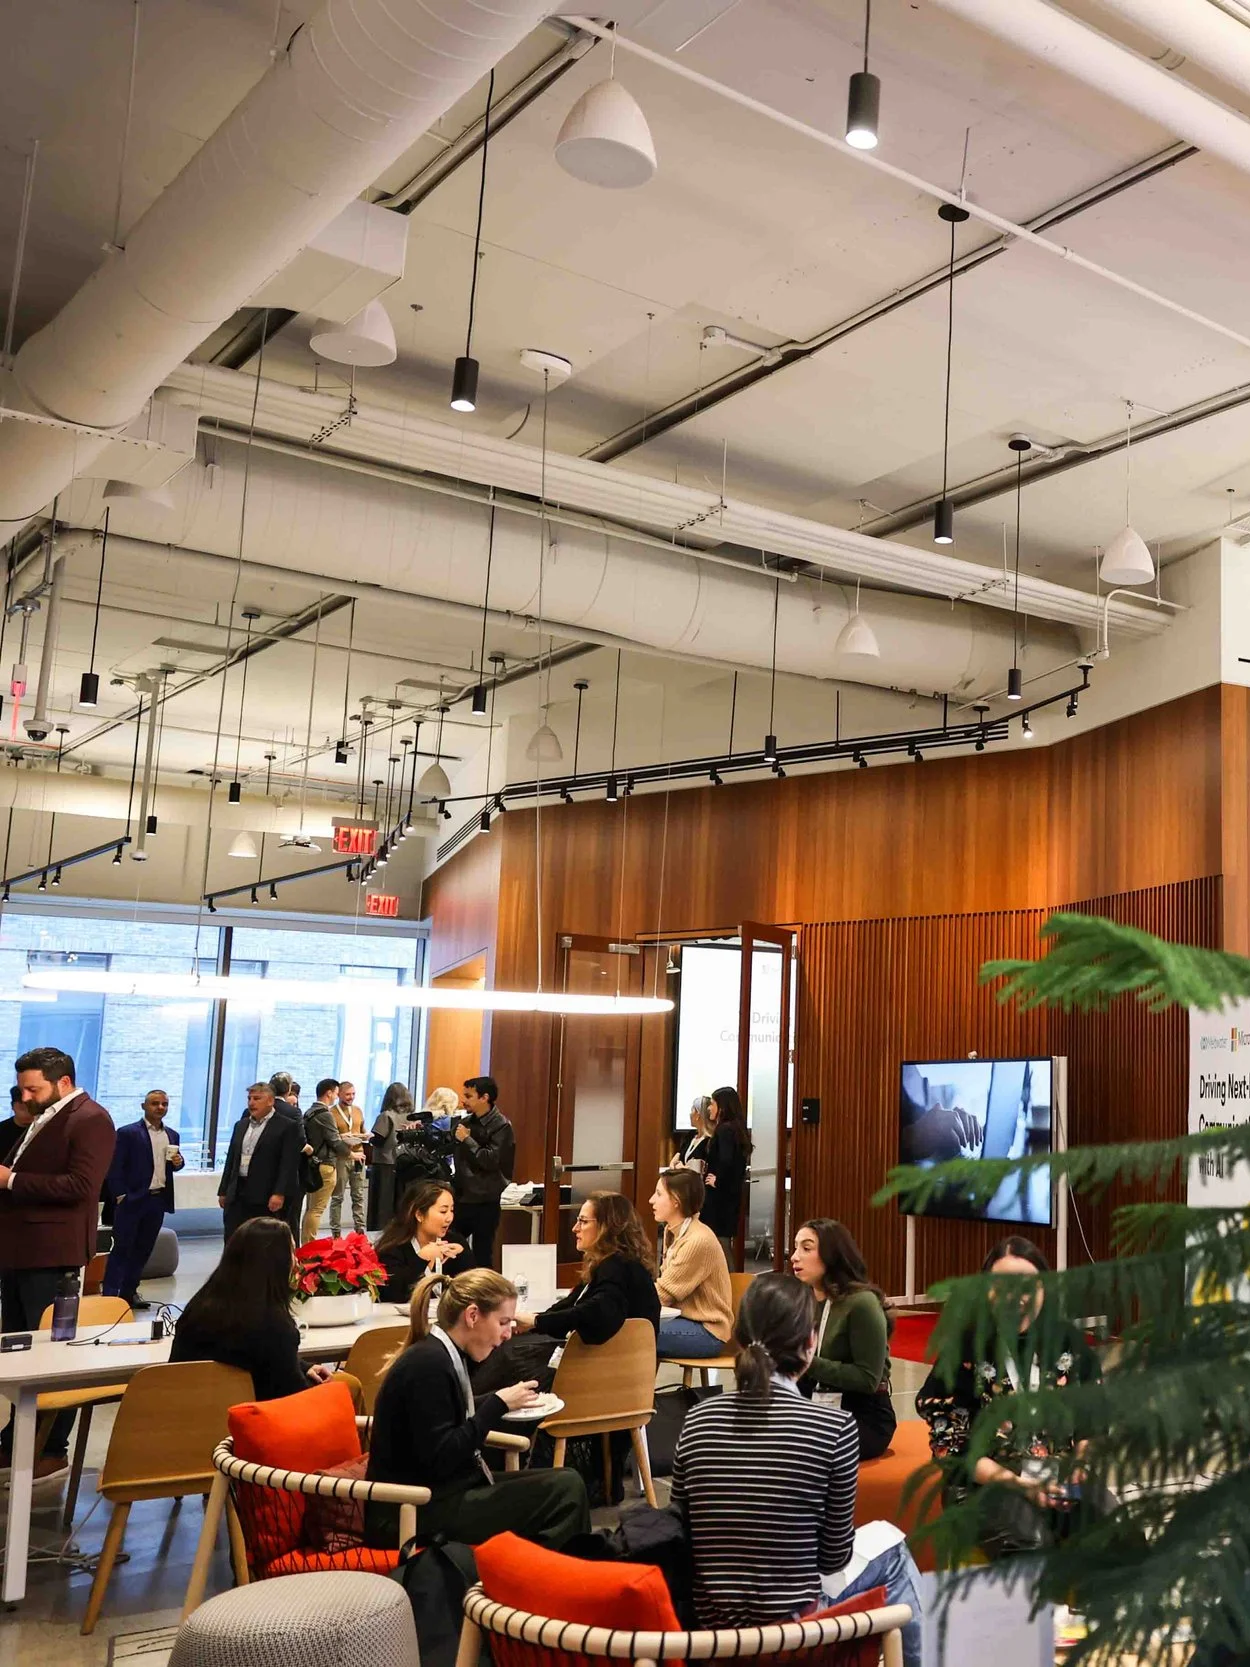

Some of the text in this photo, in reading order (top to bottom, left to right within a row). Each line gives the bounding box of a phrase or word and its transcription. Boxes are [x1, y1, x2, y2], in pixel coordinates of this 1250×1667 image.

[338, 827, 373, 854] EXIT
[370, 895, 397, 915] EXIT
[752, 1012, 780, 1024] Drivi
[1200, 1073, 1226, 1107] Driving
